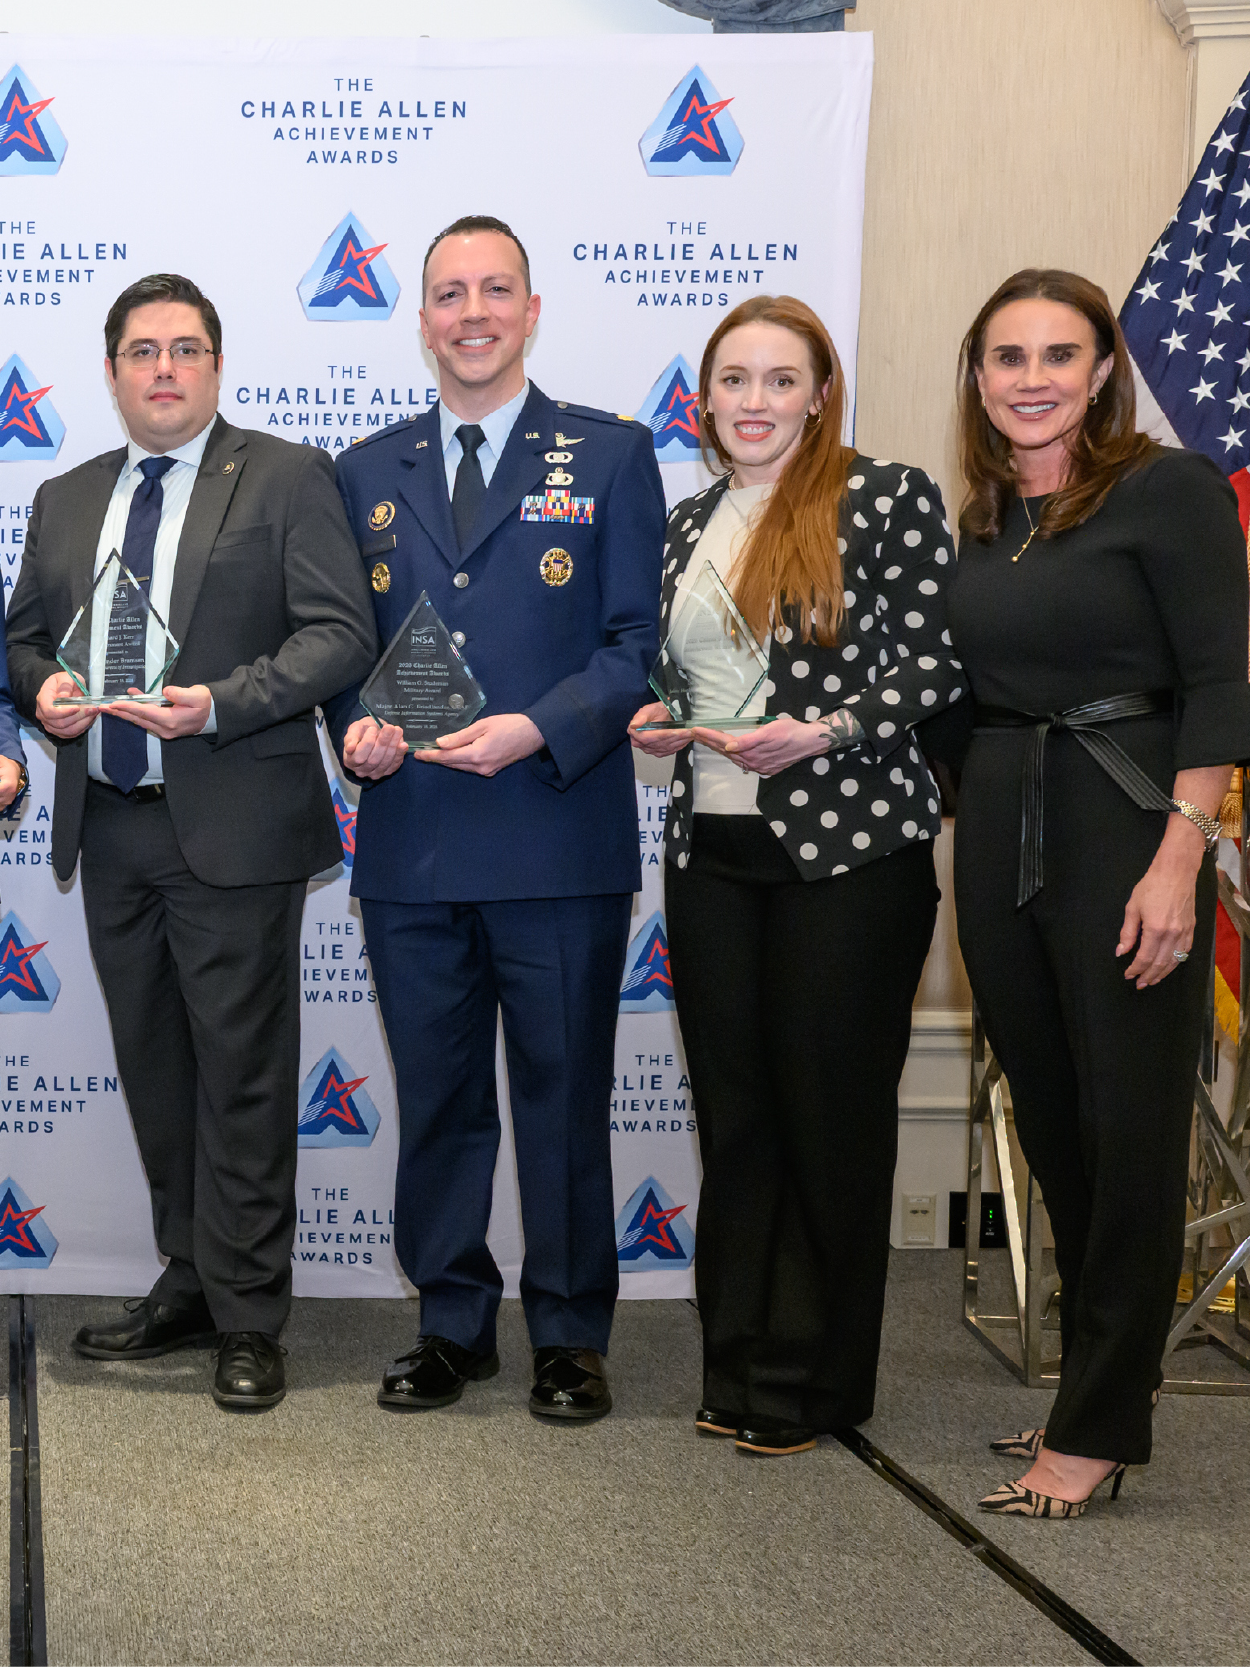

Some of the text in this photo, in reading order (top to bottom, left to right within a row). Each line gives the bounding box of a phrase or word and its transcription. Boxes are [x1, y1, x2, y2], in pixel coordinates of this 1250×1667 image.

[334, 79, 373, 91] THE
[241, 101, 466, 118] CHARLIE ALLEN
[273, 127, 433, 140] ACHIEVEMENT
[307, 150, 397, 164] AWARDS
[667, 222, 706, 235] THE
[40, 243, 126, 260] ALLEN
[574, 244, 797, 261] CHARLIE ALLEN
[605, 270, 764, 283] ACHIEVEMENT
[637, 293, 728, 306] AWARDS
[328, 366, 366, 379] THE
[237, 387, 437, 405] CHARLIE ALLE
[267, 413, 409, 426] ACHIEVEMEN
[114, 590, 127, 599] SA
[412, 635, 435, 644] INSA
[643, 785, 667, 797] TH
[316, 923, 353, 935] THE
[304, 991, 377, 1003] WARDS
[635, 1055, 673, 1066] THE
[34, 1076, 117, 1091] ALLEN
[610, 1120, 696, 1132] AWARDS
[312, 1188, 348, 1200] THE
[353, 1210, 394, 1224] ALL
[300, 1233, 390, 1244] IEVEMEN
